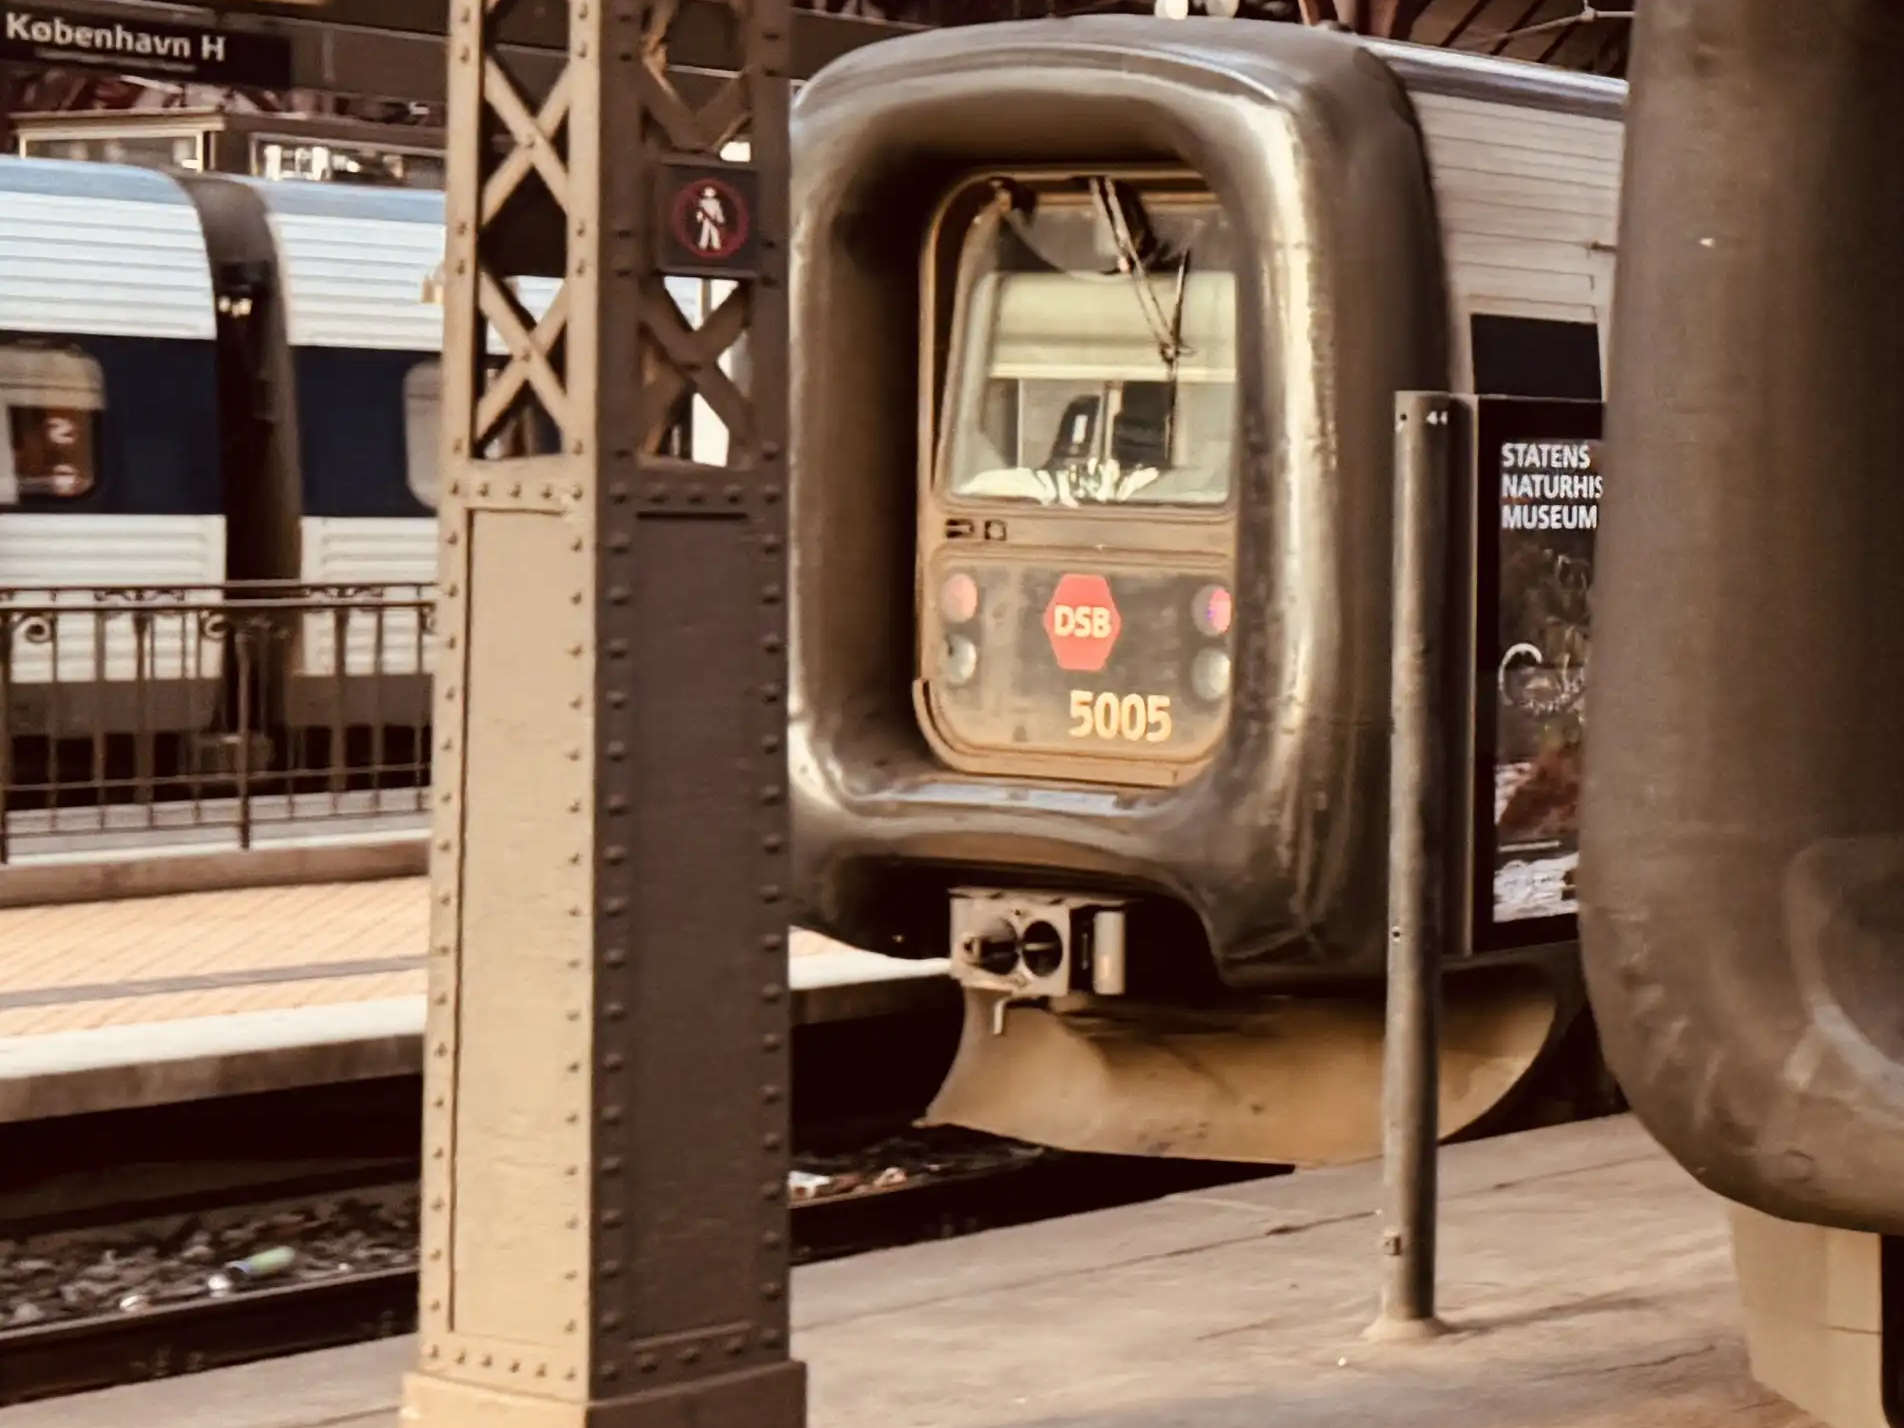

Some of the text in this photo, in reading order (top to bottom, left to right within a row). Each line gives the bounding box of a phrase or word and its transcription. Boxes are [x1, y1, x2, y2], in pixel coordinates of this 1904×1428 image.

[5, 12, 191, 58] København
[201, 34, 226, 62] H
[1501, 441, 1592, 470] STATENS
[1501, 503, 1598, 531] MUSEUM
[1053, 604, 1112, 639] DSB
[1067, 689, 1173, 743] 5005
